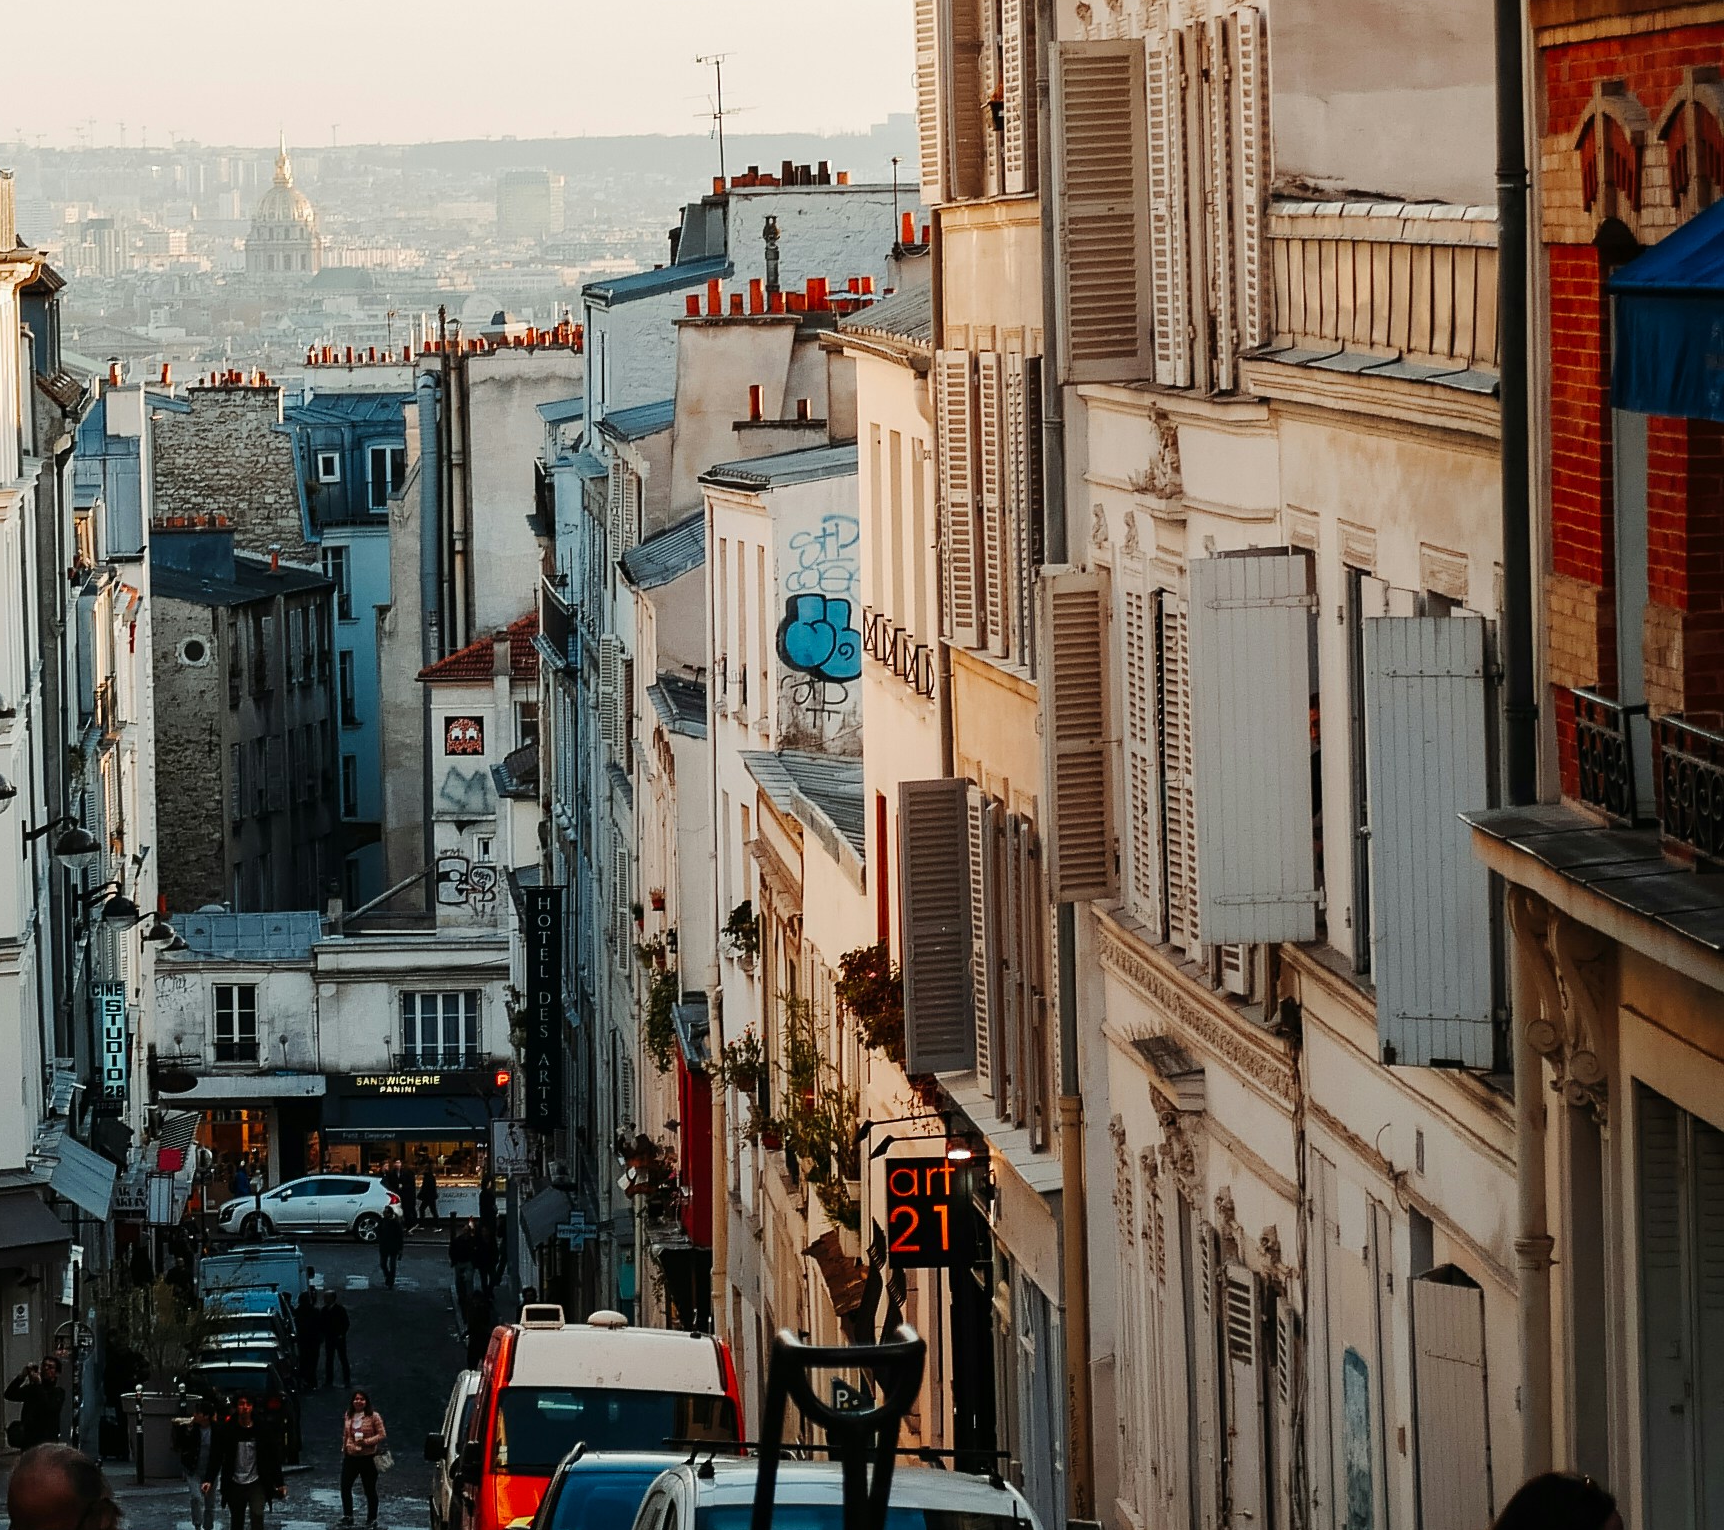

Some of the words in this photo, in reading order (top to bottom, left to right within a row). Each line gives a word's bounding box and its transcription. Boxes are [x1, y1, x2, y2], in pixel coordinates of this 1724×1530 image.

[537, 896, 551, 979] HOTEL
[92, 982, 123, 997] CINE
[538, 991, 551, 1038] DES
[104, 999, 124, 1082] STUDIO
[104, 1084, 125, 1099] 28
[355, 1075, 441, 1087] SANDWICHERIE
[379, 1086, 417, 1094] PANINI
[537, 1053, 551, 1117] ARTS
[889, 1158, 956, 1198] art
[889, 1204, 950, 1253] 21
